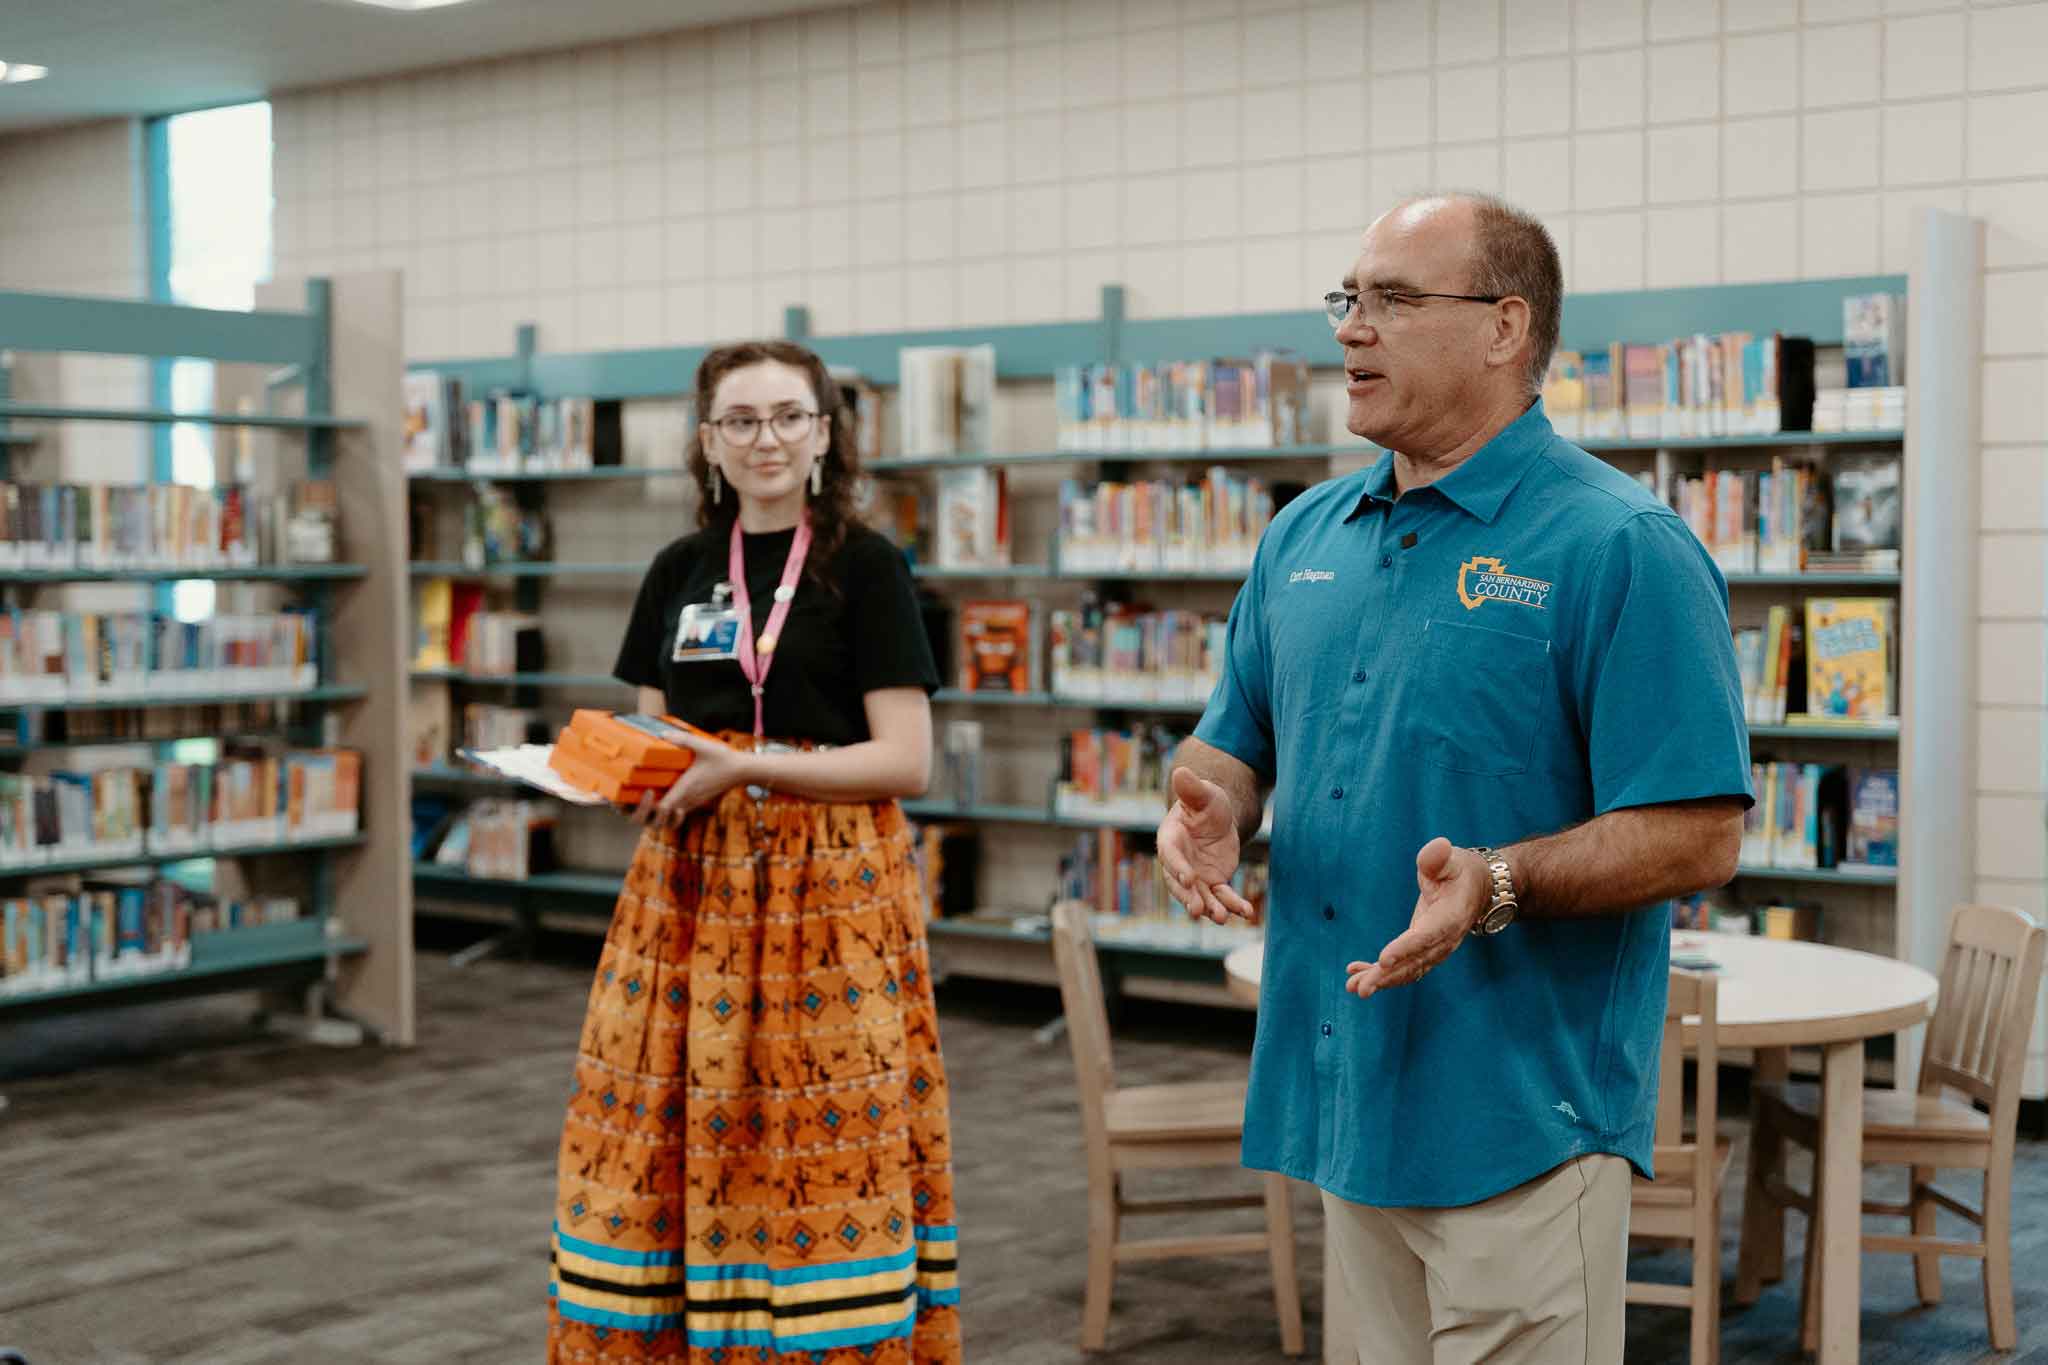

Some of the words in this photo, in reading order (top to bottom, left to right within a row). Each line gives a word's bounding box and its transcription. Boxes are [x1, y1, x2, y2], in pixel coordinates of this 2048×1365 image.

[1480, 574, 1495, 583] SAN
[1496, 575, 1550, 592] BERNARDINO
[1474, 582, 1548, 605] COUNTY
